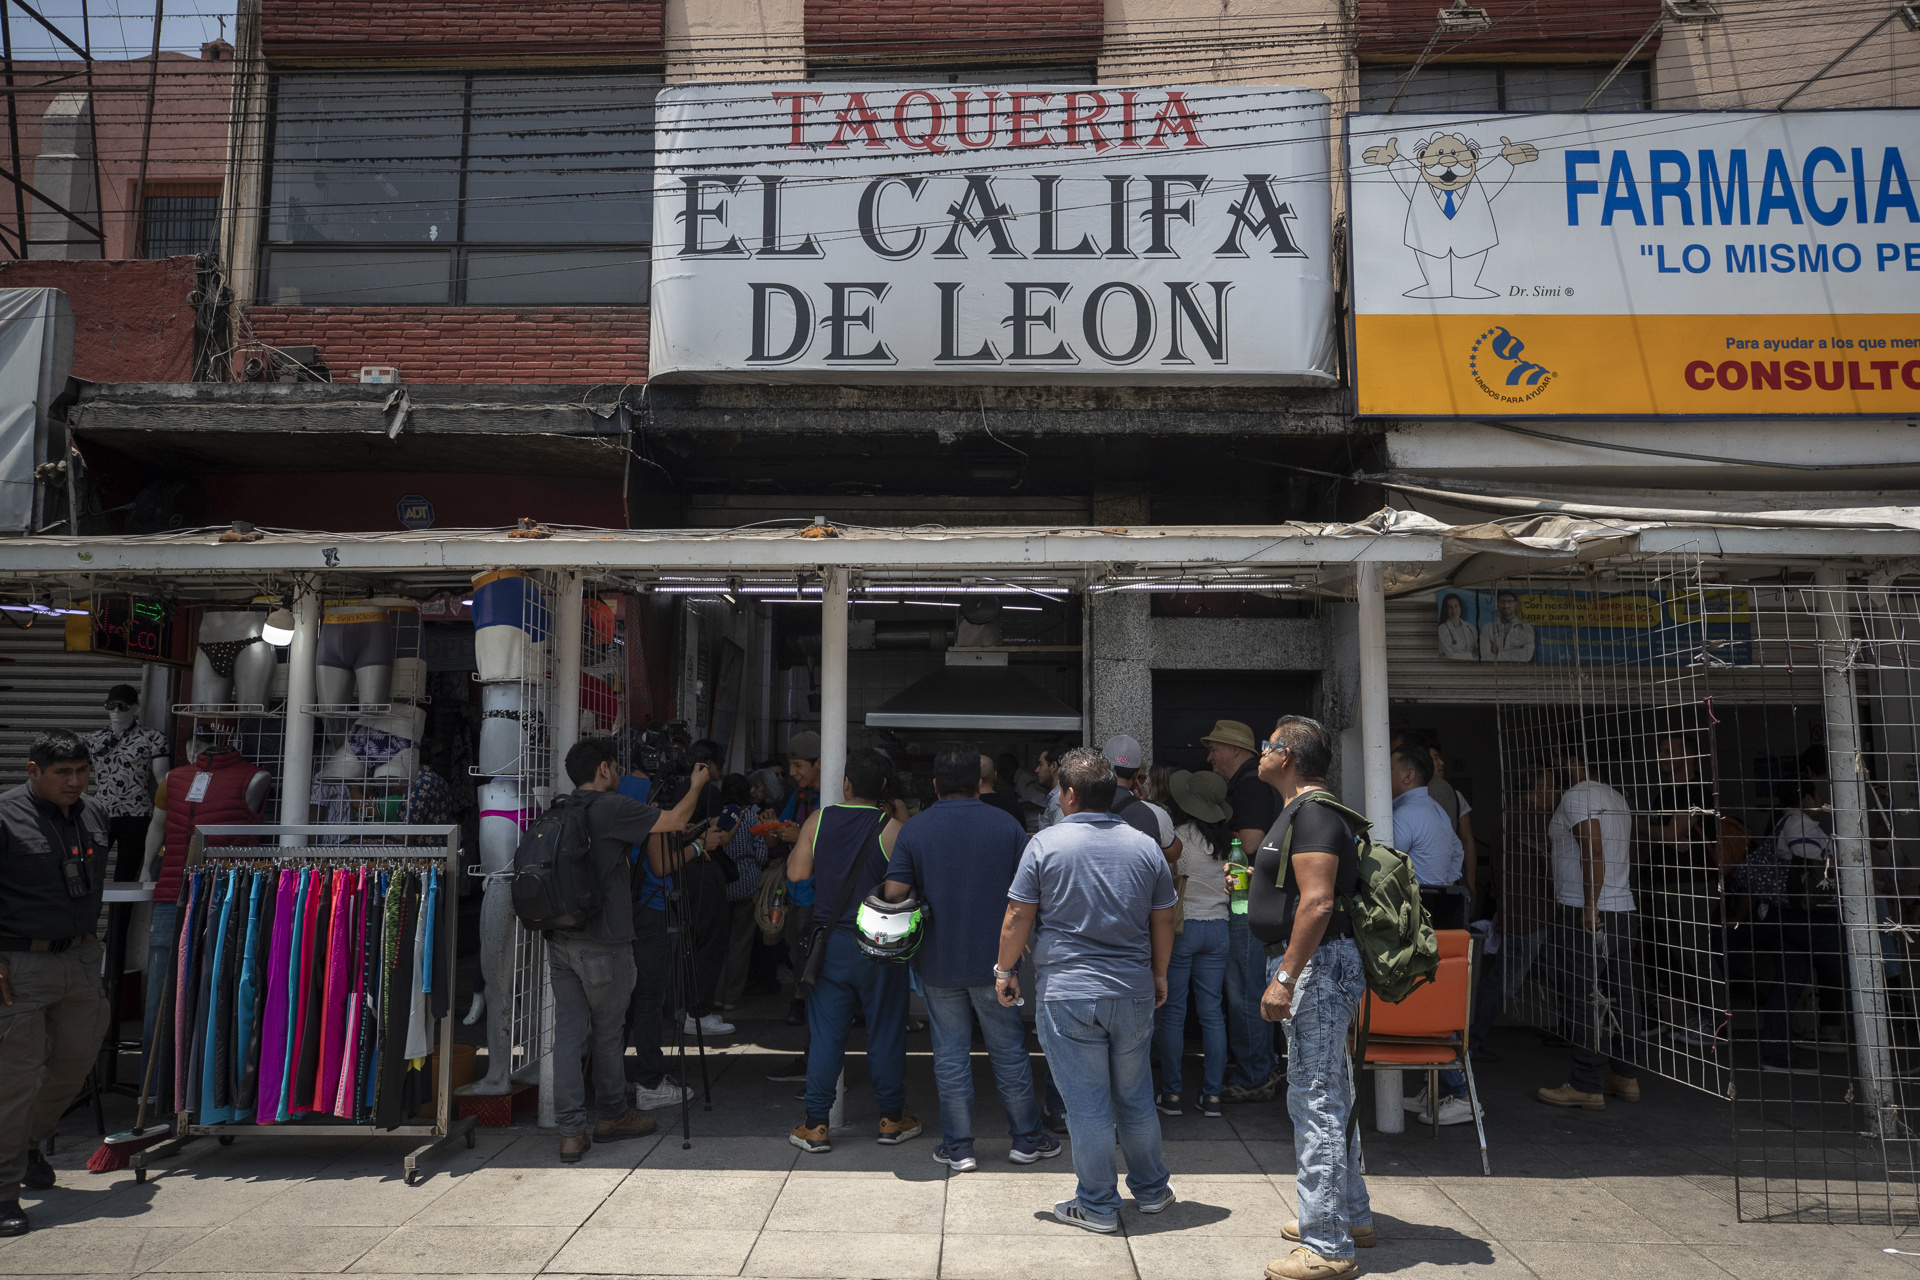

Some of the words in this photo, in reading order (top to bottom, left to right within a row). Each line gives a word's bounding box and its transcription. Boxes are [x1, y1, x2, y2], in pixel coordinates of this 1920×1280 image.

[772, 91, 1209, 155] TAQUERIA
[1565, 146, 1920, 226] FARMACIA
[674, 174, 824, 261] EL
[857, 174, 1308, 261] CALIFA
[1640, 243, 1711, 274] "LO
[1725, 243, 1862, 273] MISMO
[1509, 285, 1529, 297] Dr.
[1532, 285, 1561, 297] Simi
[744, 281, 899, 366] DE
[933, 281, 1235, 366] LEON
[1726, 337, 1760, 350] Para
[1763, 337, 1815, 352] ayudar
[1818, 339, 1828, 349] a
[1831, 336, 1854, 349] los
[1857, 338, 1887, 352] que
[1475, 376, 1500, 400] UNIDOS
[1501, 395, 1524, 403] PARA
[1525, 376, 1552, 402] AYUDAR
[405, 506, 428, 519] ADT
[327, 614, 355, 623] Calvin
[356, 612, 380, 621] Klein
[426, 638, 475, 658] OPE
